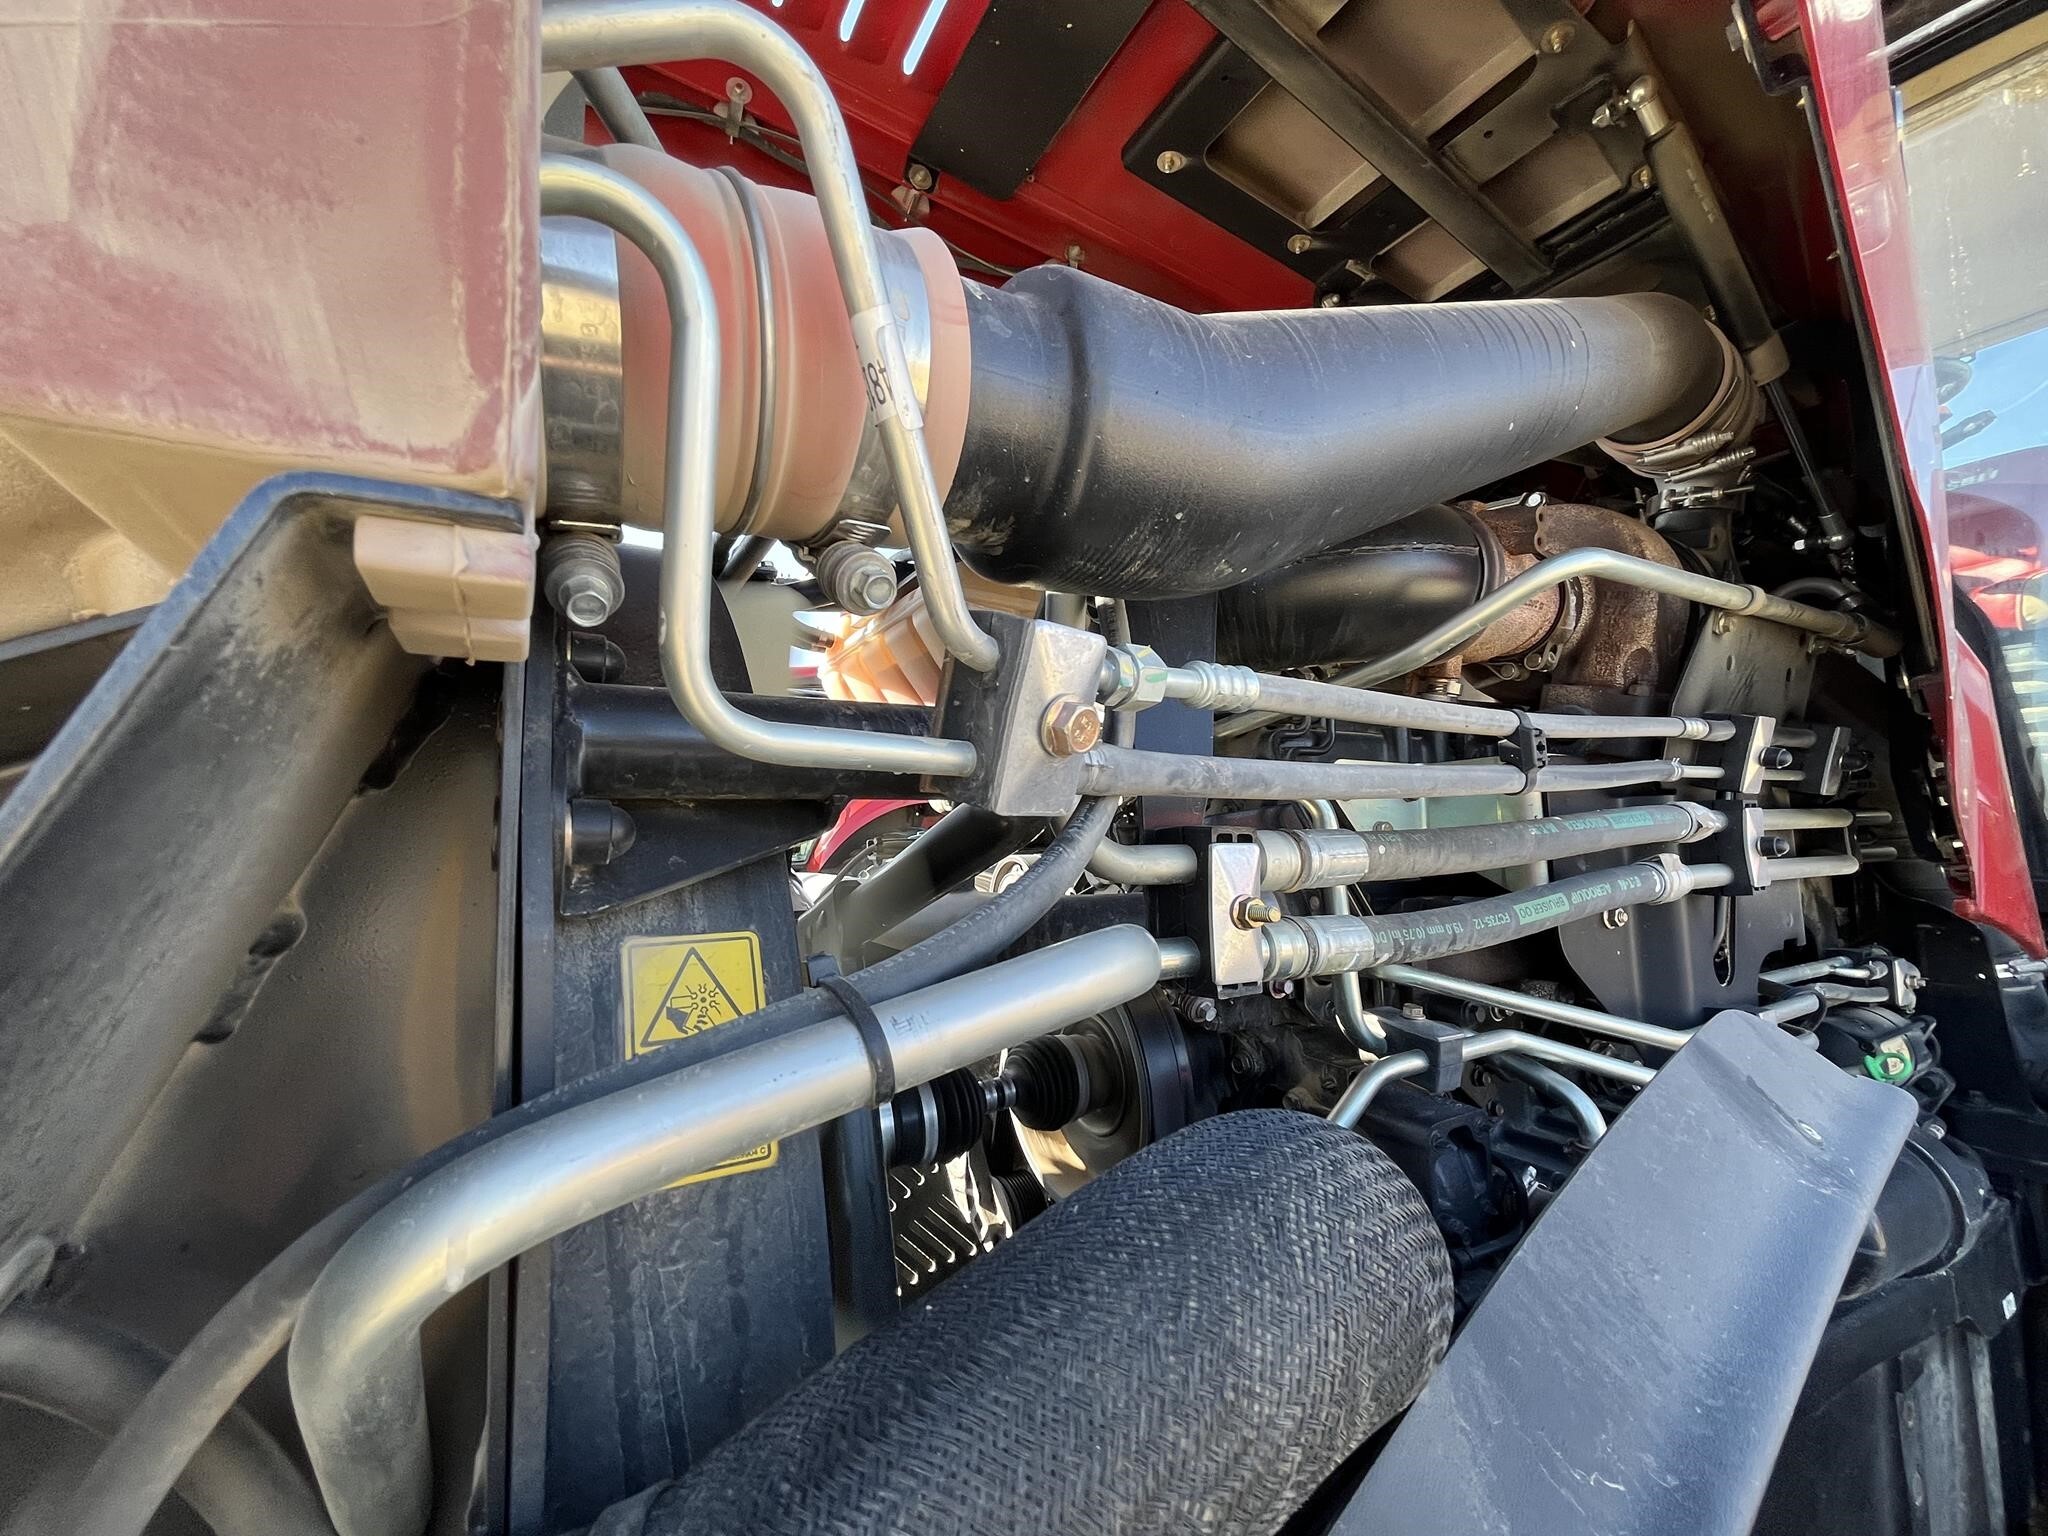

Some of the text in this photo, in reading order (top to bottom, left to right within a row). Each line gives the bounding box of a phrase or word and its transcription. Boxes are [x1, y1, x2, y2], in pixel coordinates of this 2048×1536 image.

[1571, 882, 1612, 905] AEROQUIP
[1534, 896, 1566, 915] BRUISER
[1426, 924, 1444, 935] mm
[1446, 921, 1464, 935] 19.0
[1472, 912, 1511, 930] FC735-12
